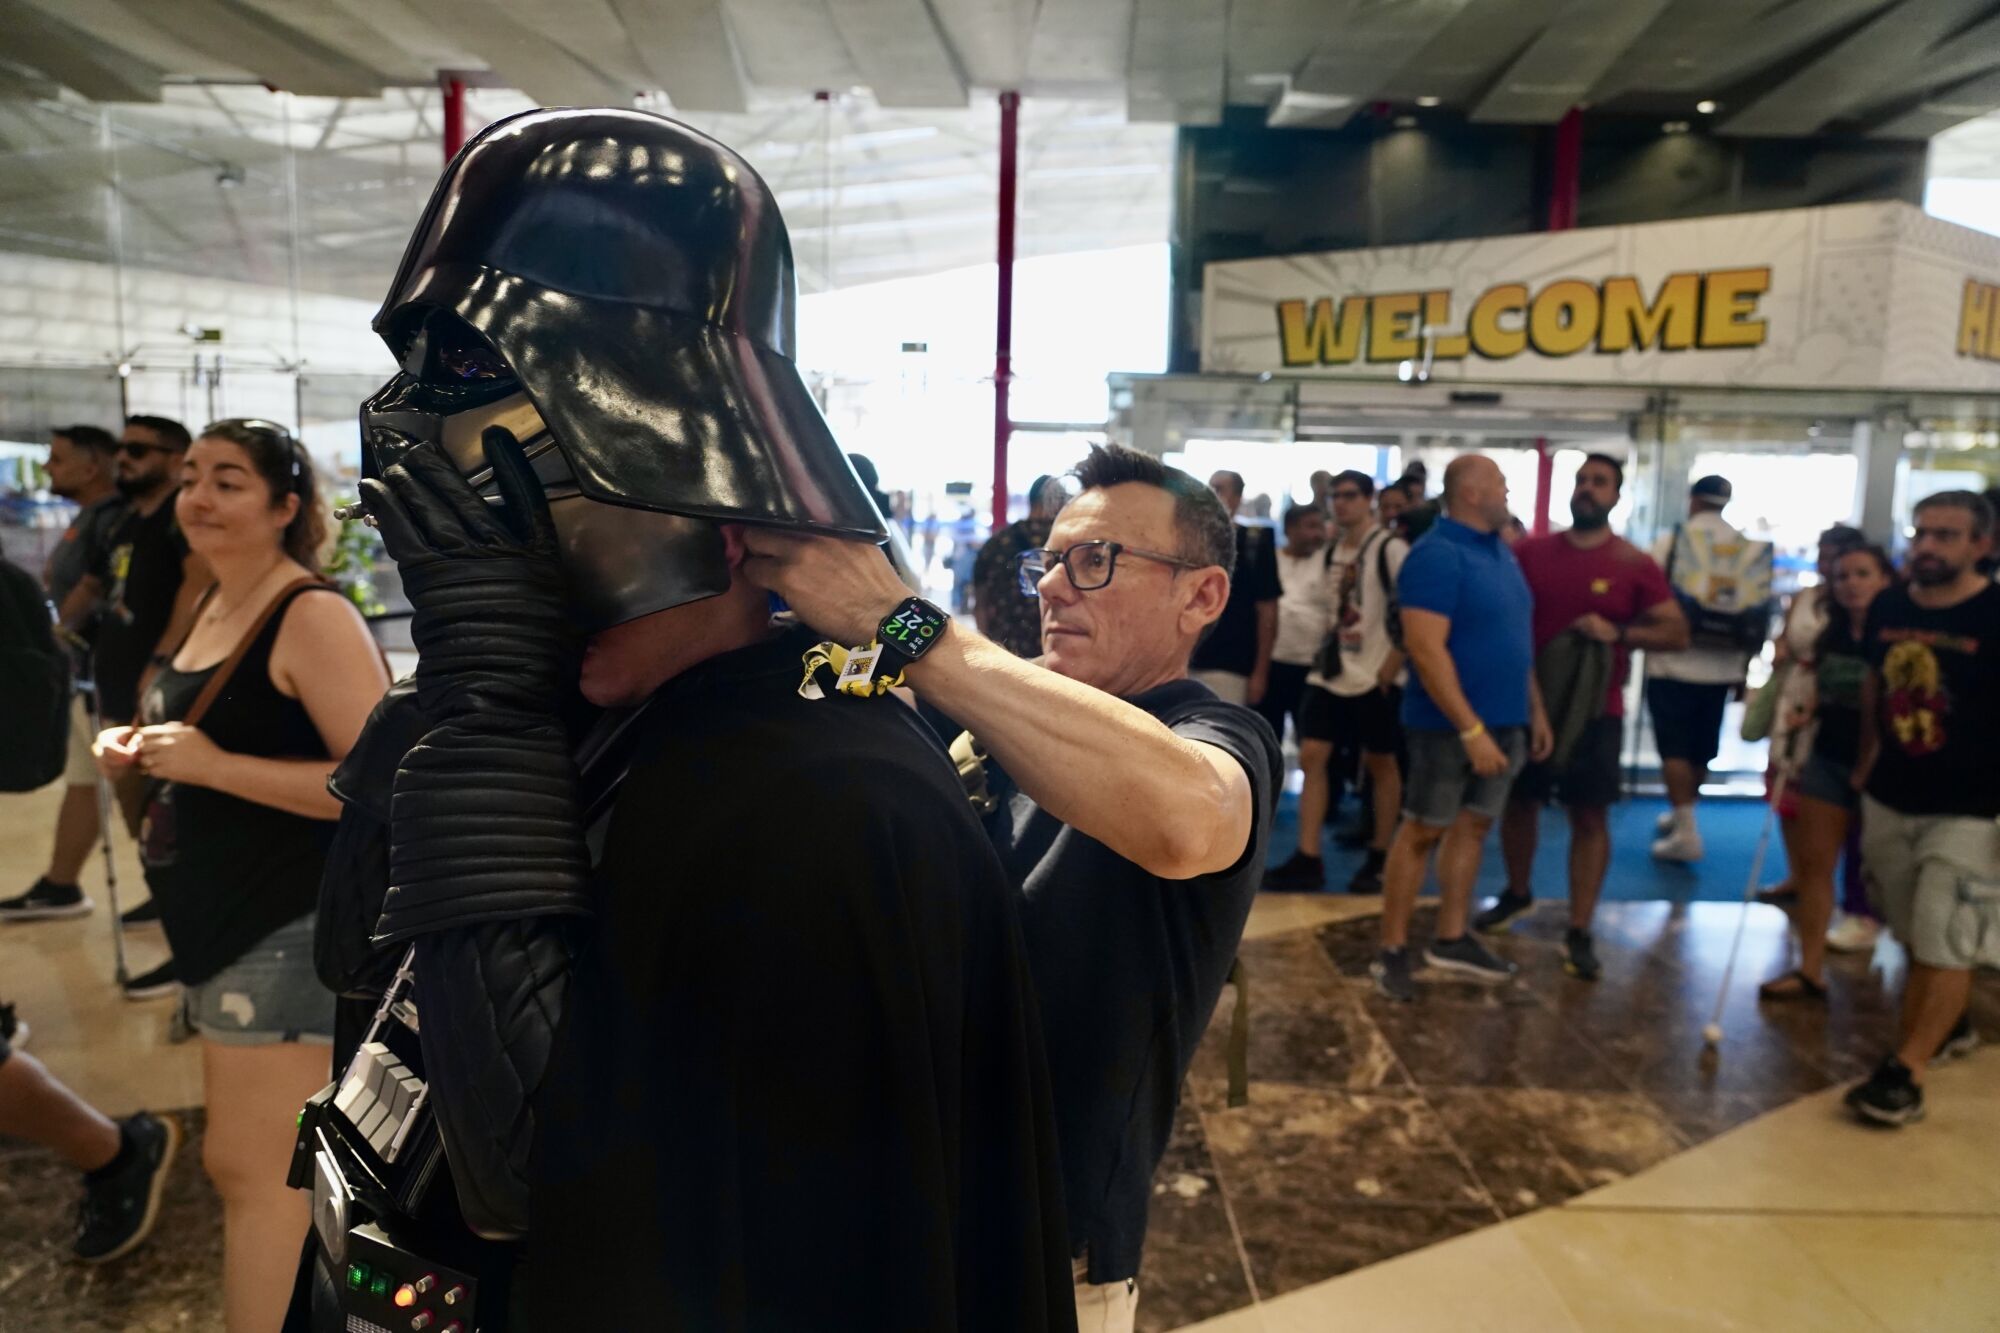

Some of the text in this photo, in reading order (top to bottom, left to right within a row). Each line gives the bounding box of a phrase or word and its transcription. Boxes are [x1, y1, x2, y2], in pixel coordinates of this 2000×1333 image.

[1277, 267, 1771, 367] WELCOME
[886, 619, 909, 640] 12
[895, 610, 923, 629] 27
